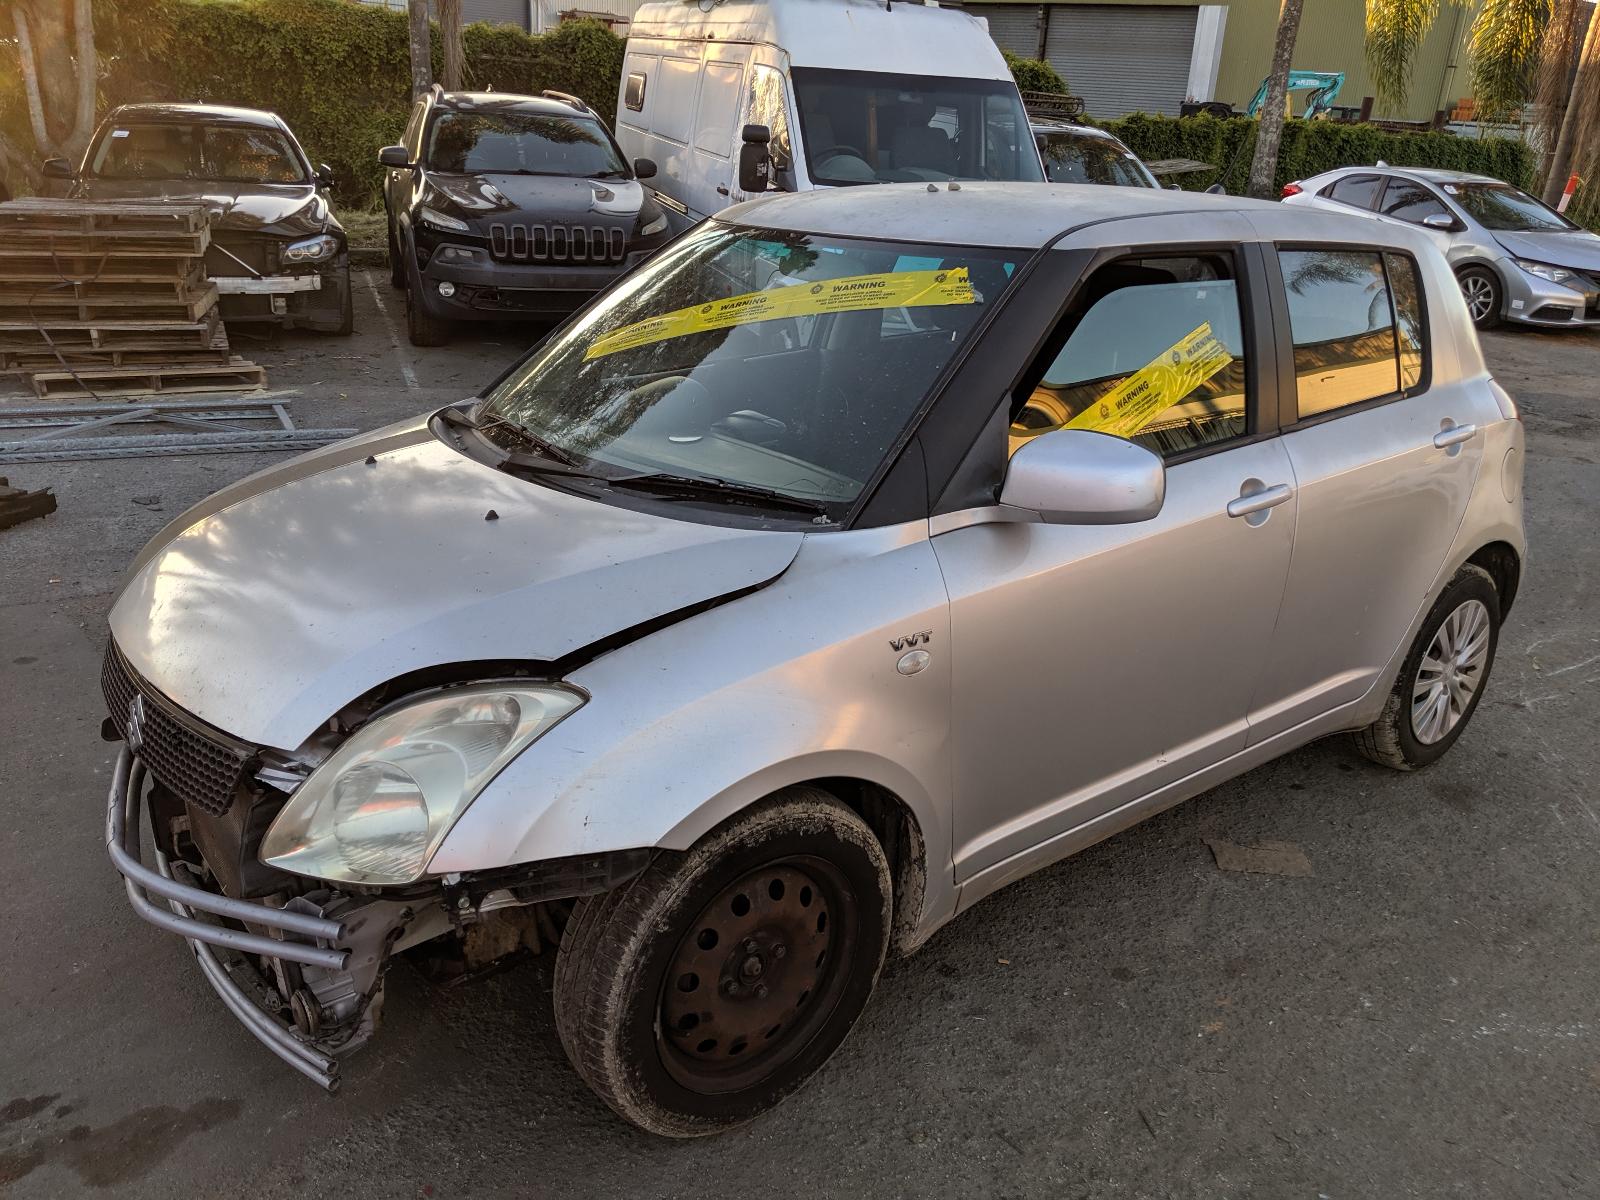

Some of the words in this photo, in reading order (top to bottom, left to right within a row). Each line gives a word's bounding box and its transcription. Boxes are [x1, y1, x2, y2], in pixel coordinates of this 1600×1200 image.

[832, 281, 886, 292] WARNING
[719, 296, 768, 311] WARNING
[1114, 380, 1149, 410] WARNING
[888, 630, 933, 652] VVT
